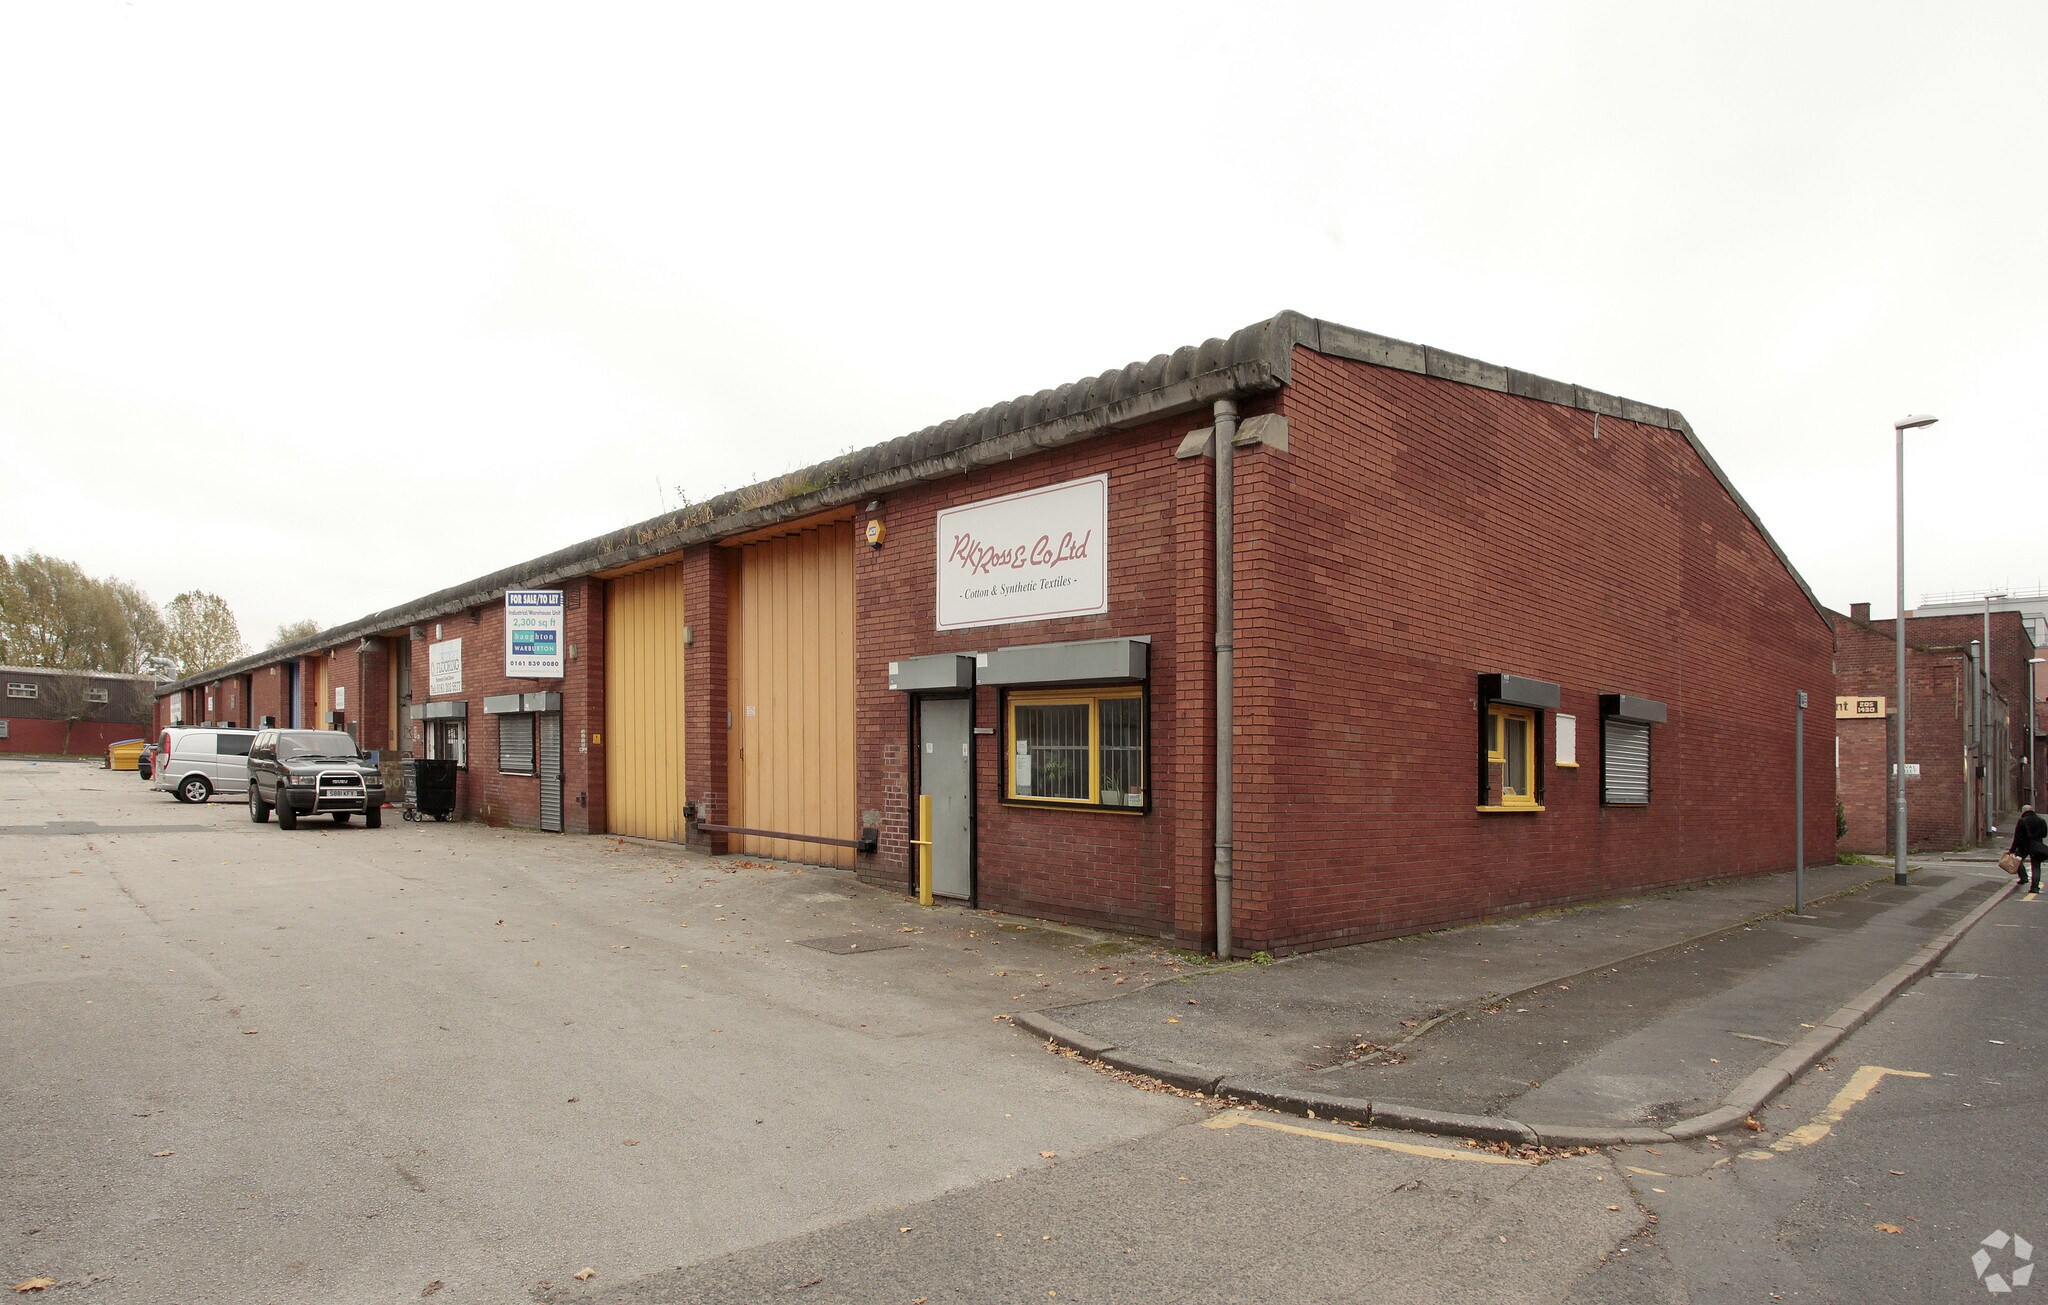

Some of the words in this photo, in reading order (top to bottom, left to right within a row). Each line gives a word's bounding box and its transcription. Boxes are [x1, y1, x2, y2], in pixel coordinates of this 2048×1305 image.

[1030, 535, 1053, 566] Co
[1050, 529, 1092, 568] Ltd
[964, 588, 989, 600] Cotton
[990, 584, 998, 596] &
[1000, 579, 1037, 597] Synthetic
[1039, 575, 1072, 590] Textiles
[510, 594, 522, 604] FOR
[523, 593, 548, 605] SALE/TO
[549, 594, 558, 604] LET
[513, 618, 536, 627] 2,300
[538, 620, 548, 628] sq
[550, 617, 556, 627] ft
[514, 632, 554, 642] haughton
